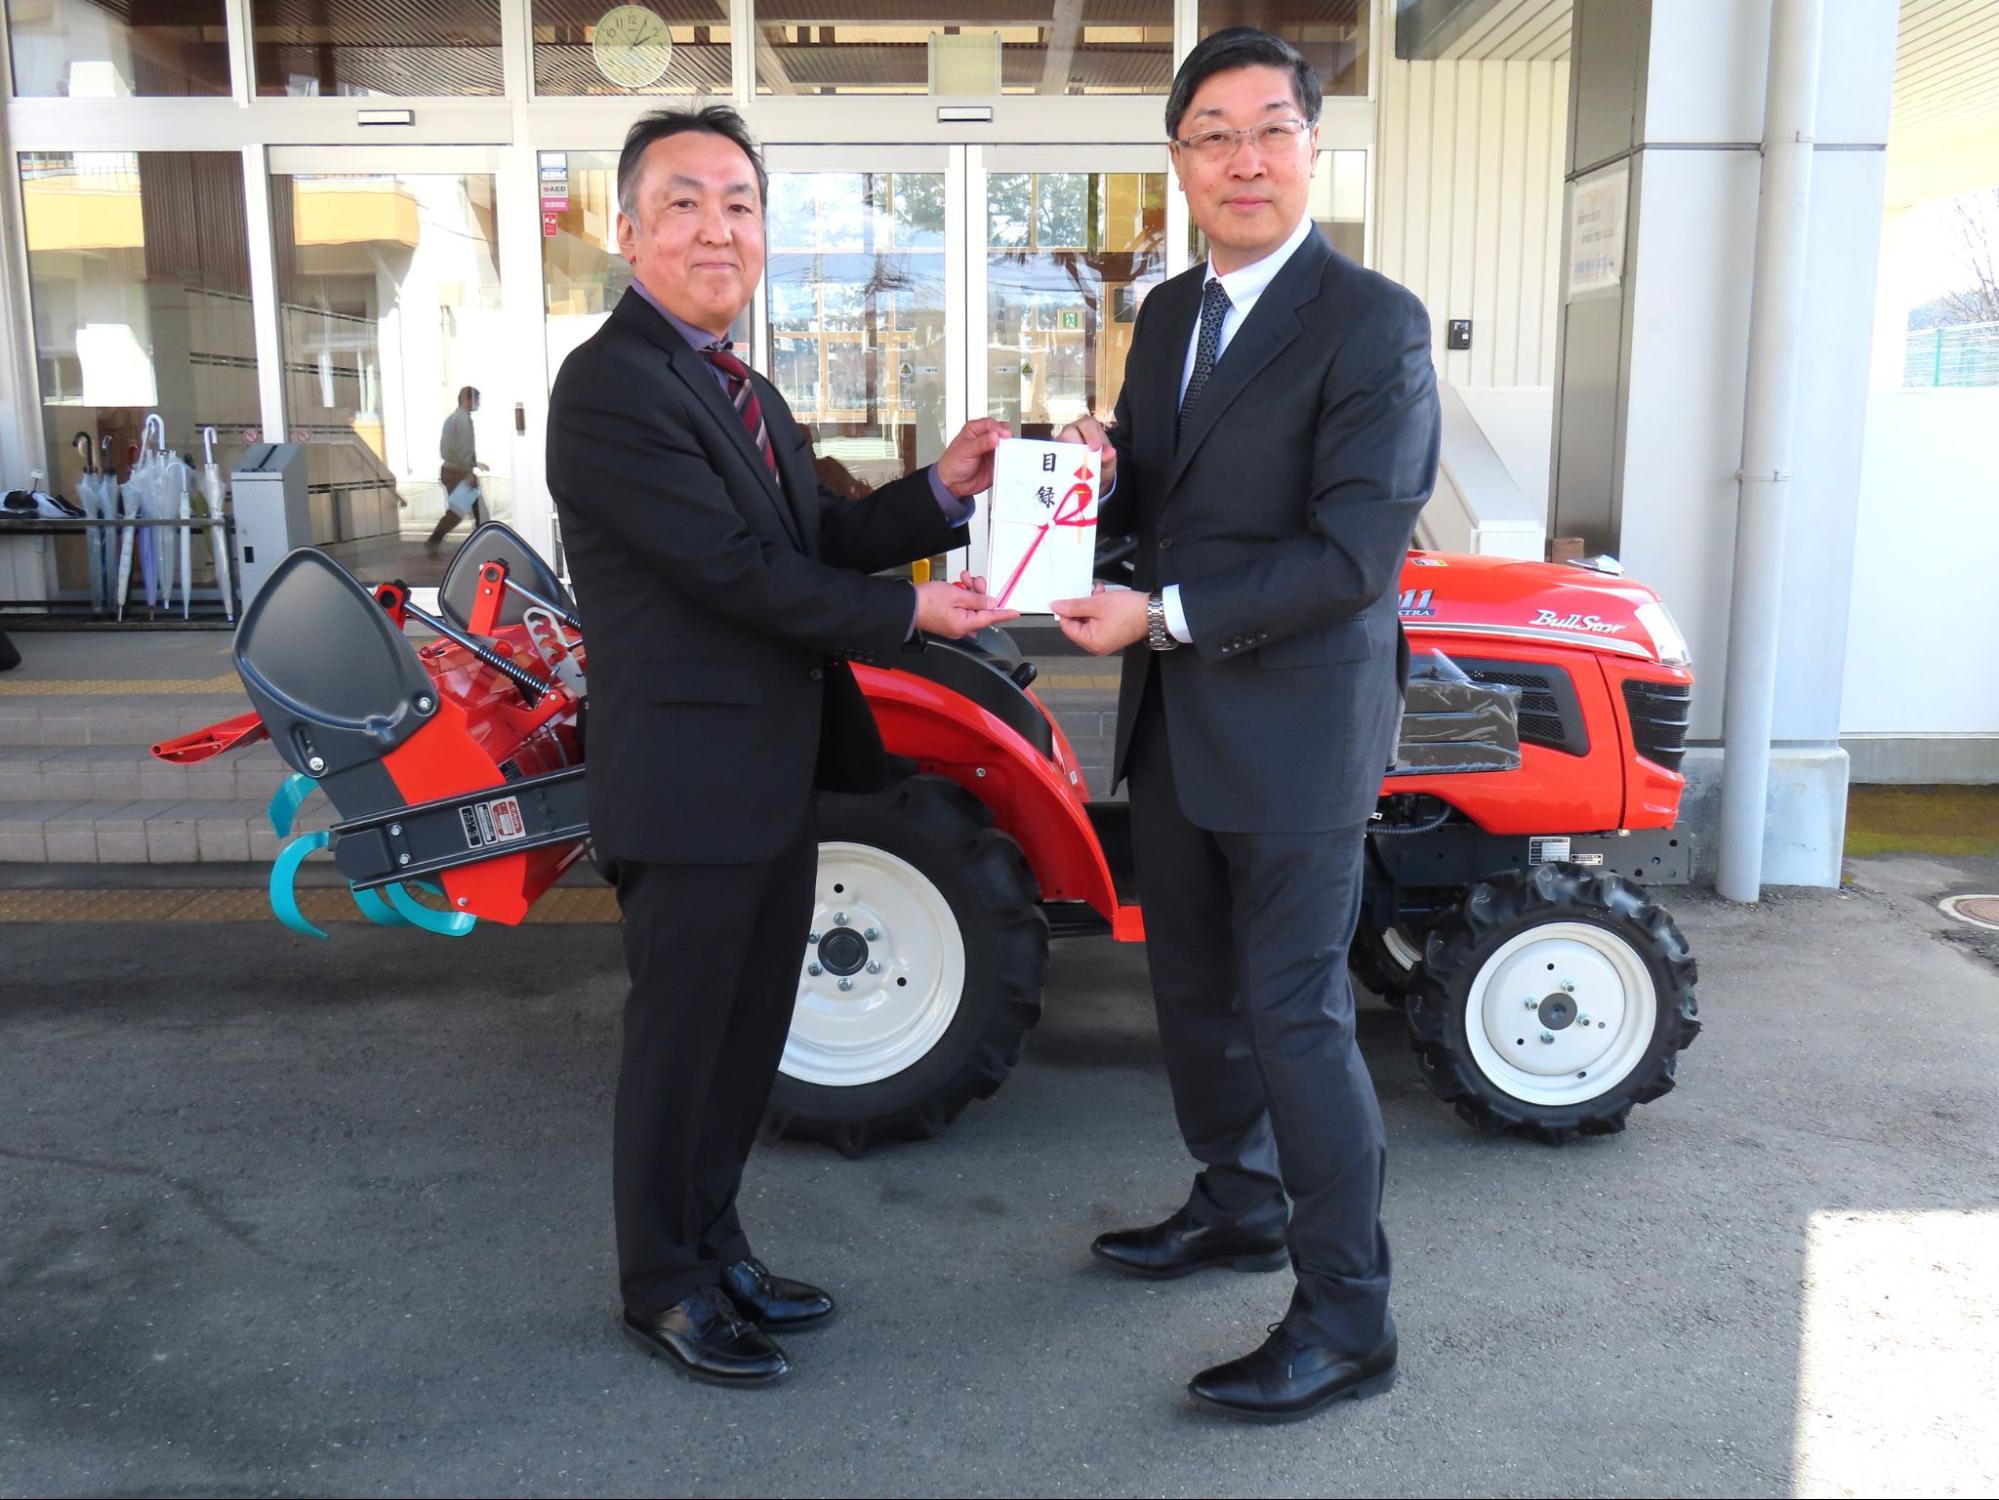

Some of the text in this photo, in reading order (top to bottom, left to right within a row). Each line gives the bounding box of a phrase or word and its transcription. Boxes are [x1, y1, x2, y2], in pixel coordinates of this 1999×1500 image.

[1036, 453, 1056, 509] 目録
[1399, 589, 1434, 609] 11
[1528, 609, 1581, 628] Bull
